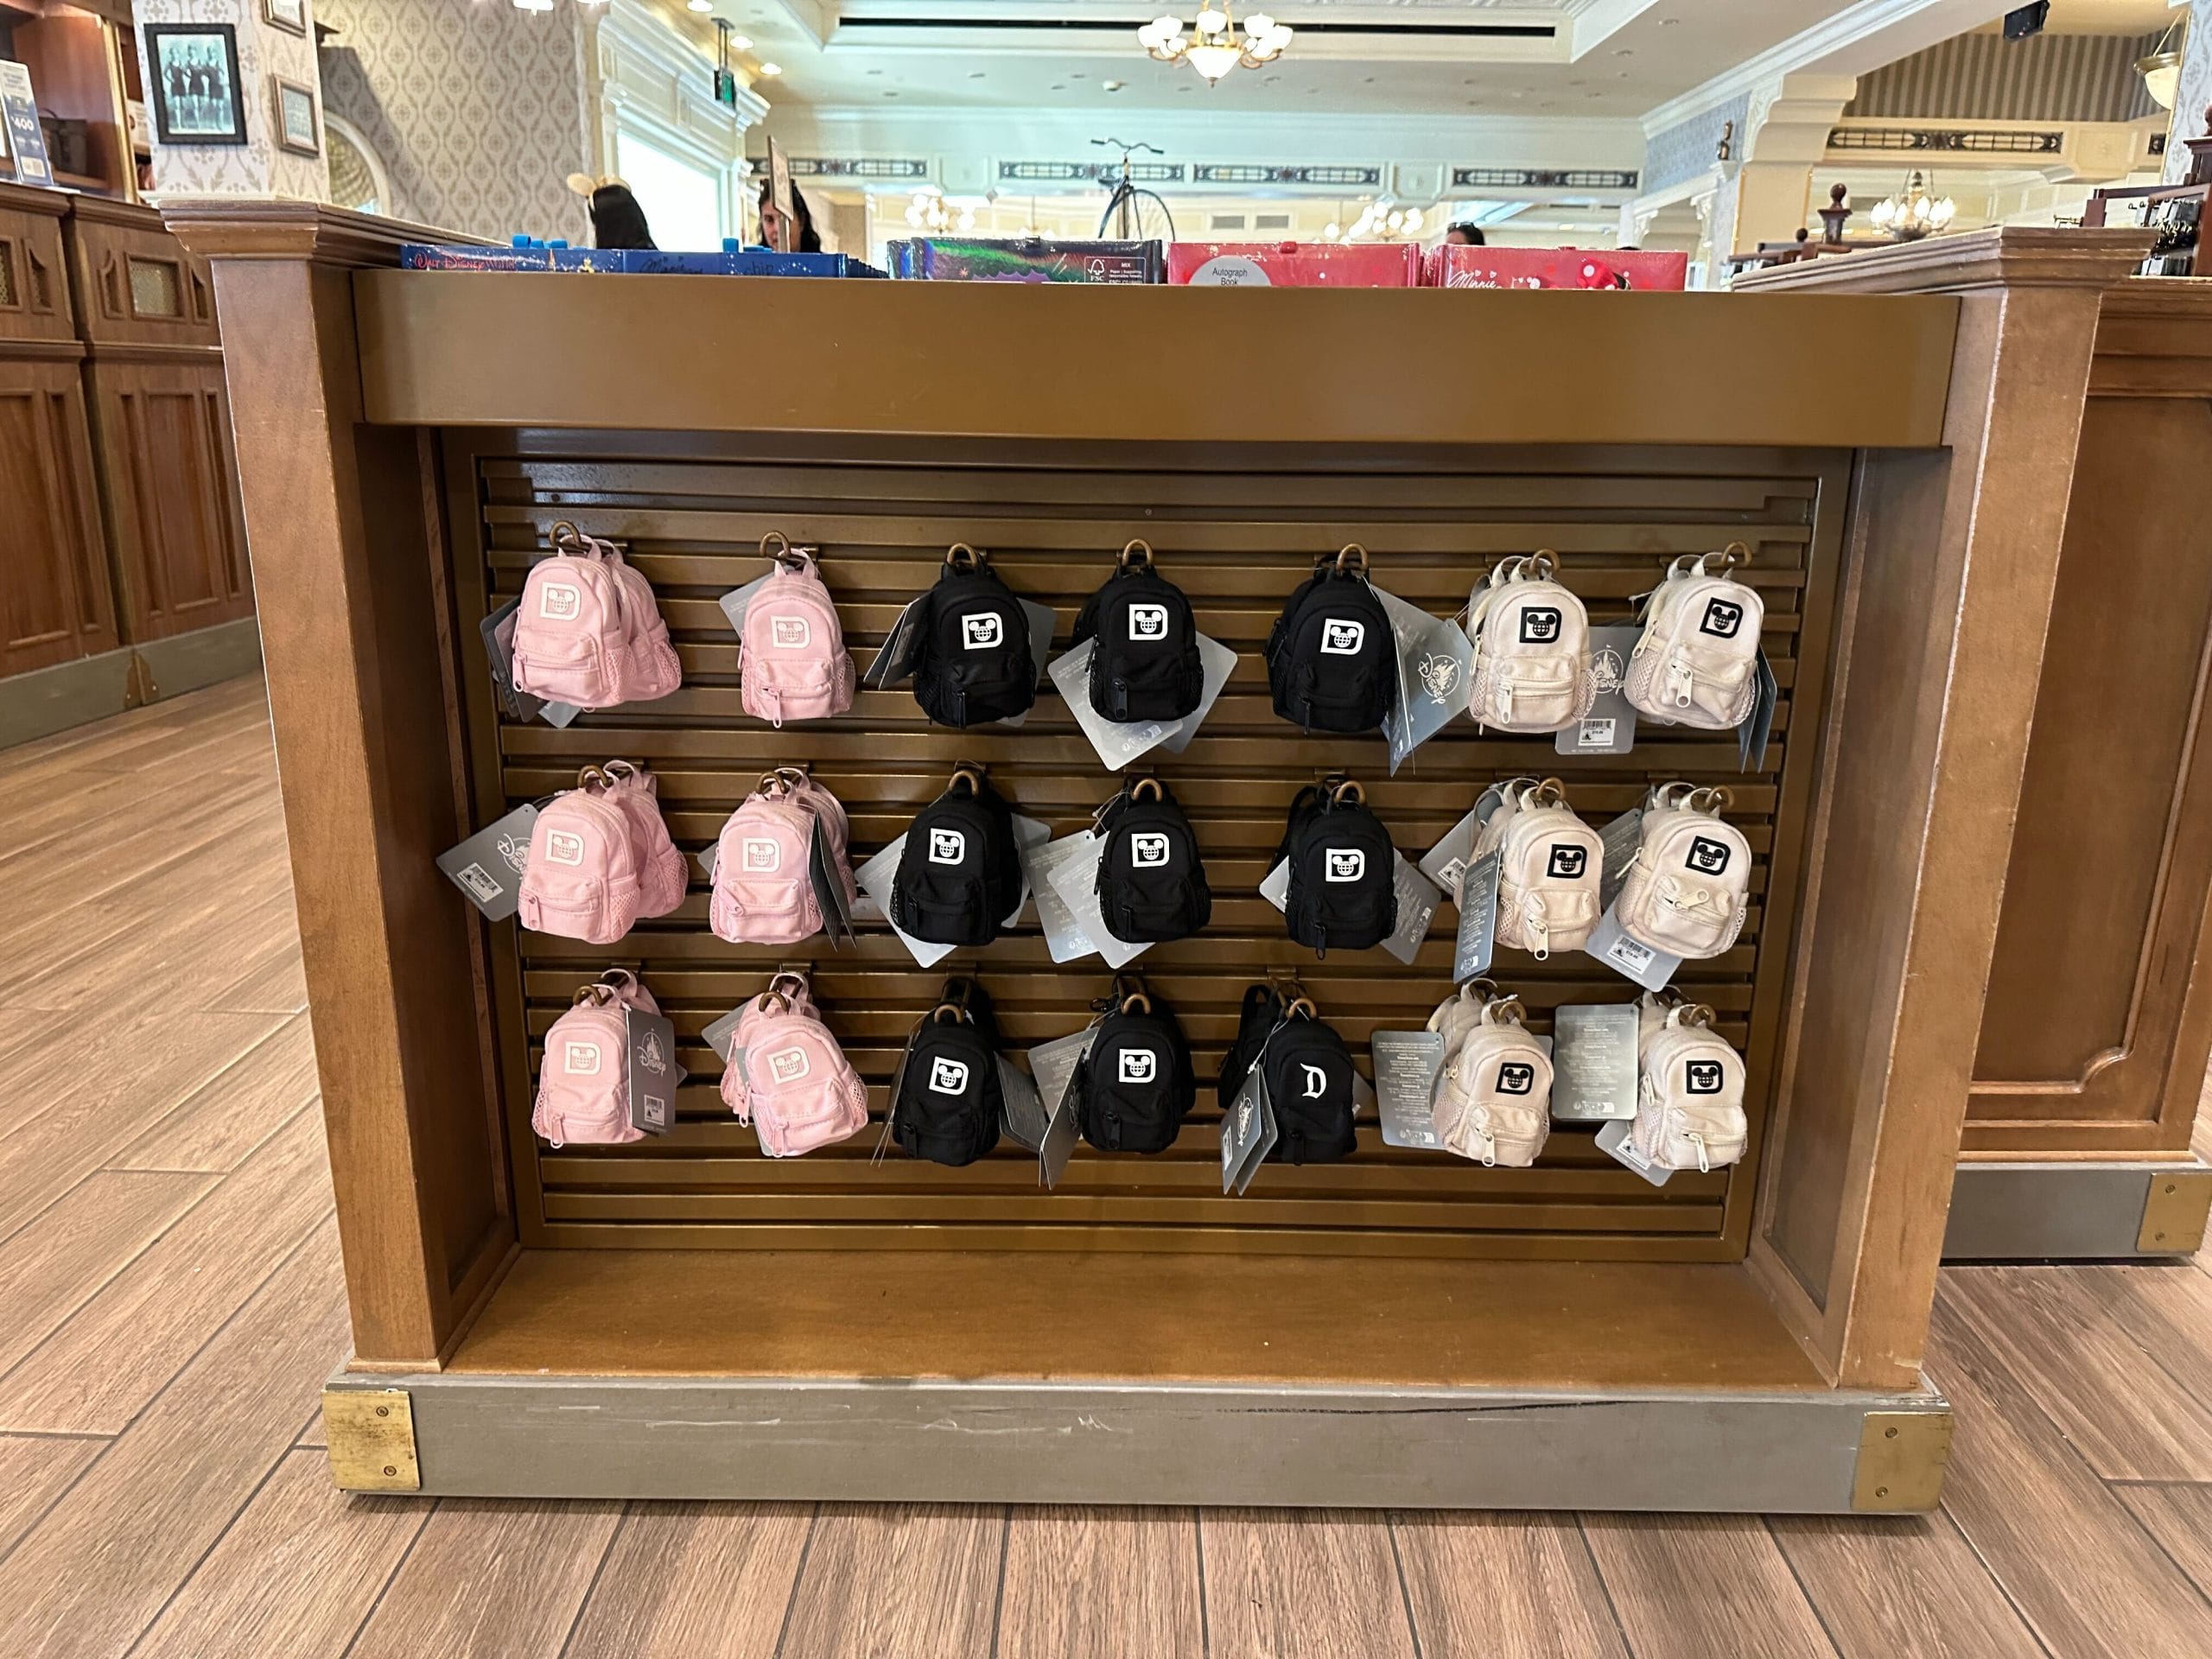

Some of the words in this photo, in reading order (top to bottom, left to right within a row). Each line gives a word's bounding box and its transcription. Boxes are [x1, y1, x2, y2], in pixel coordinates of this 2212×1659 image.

[1212, 267, 1248, 278] Autograph
[1446, 270, 1497, 289] Minnie
[1300, 1063, 1327, 1099] D
